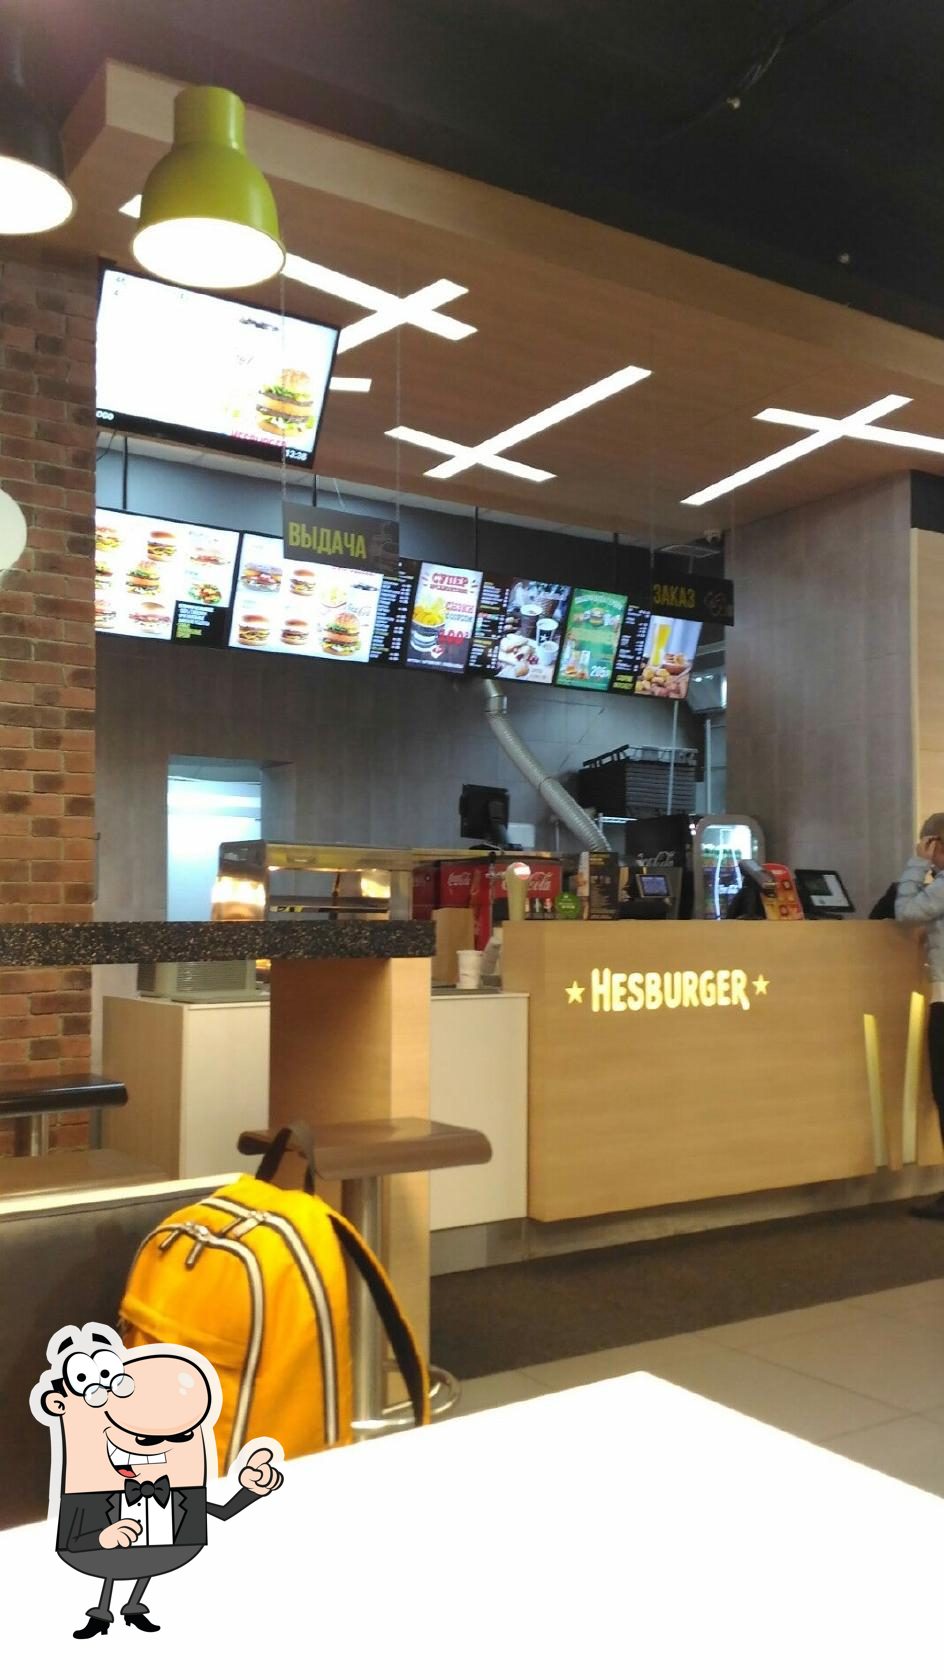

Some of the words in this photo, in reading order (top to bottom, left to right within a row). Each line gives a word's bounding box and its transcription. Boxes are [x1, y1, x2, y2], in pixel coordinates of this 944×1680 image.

[288, 522, 367, 559] ВЫДАЧА
[431, 572, 469, 588] СУПЕР
[653, 584, 696, 609] ЗАКАЗ
[591, 967, 750, 1013] HESBURGER
